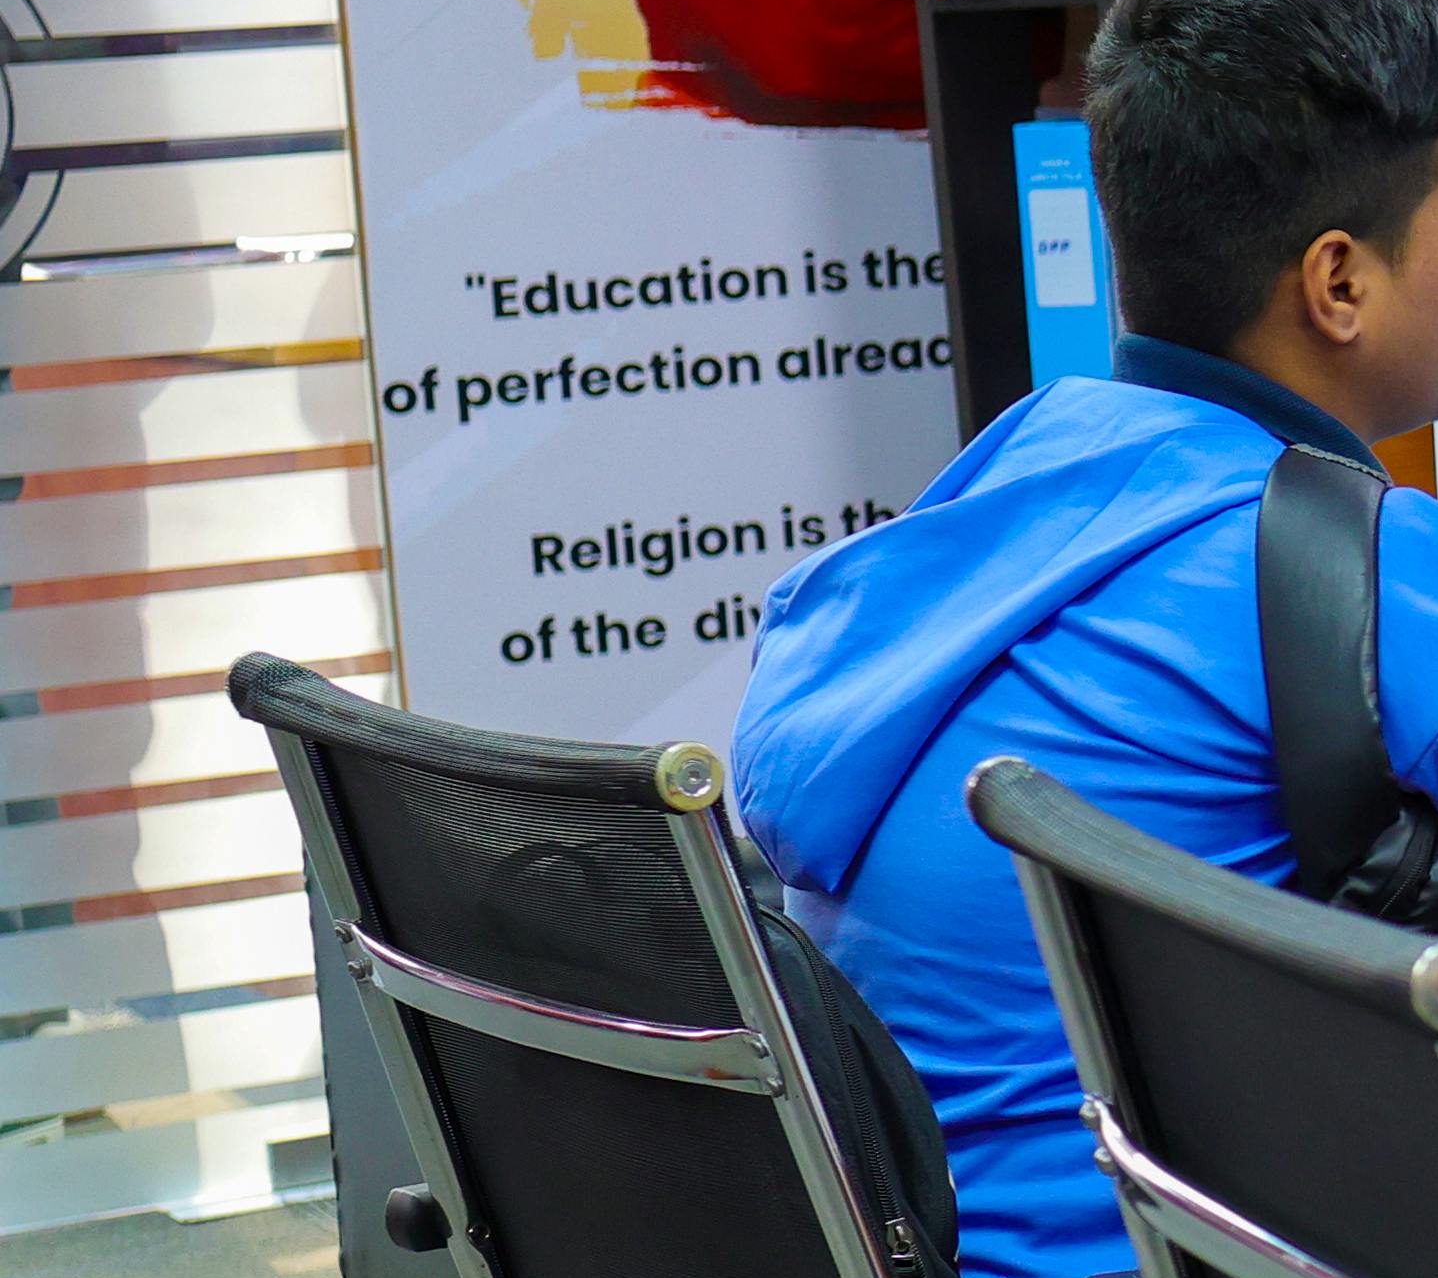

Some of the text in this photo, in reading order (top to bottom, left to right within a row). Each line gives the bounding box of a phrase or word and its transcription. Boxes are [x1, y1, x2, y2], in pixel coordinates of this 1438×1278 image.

[465, 253, 789, 321] "Education
[804, 249, 848, 295] is
[382, 367, 439, 416] of
[458, 343, 760, 424] perfection
[531, 517, 766, 577] Religion
[782, 503, 826, 548] is
[502, 613, 556, 663] of
[570, 610, 667, 655] the
